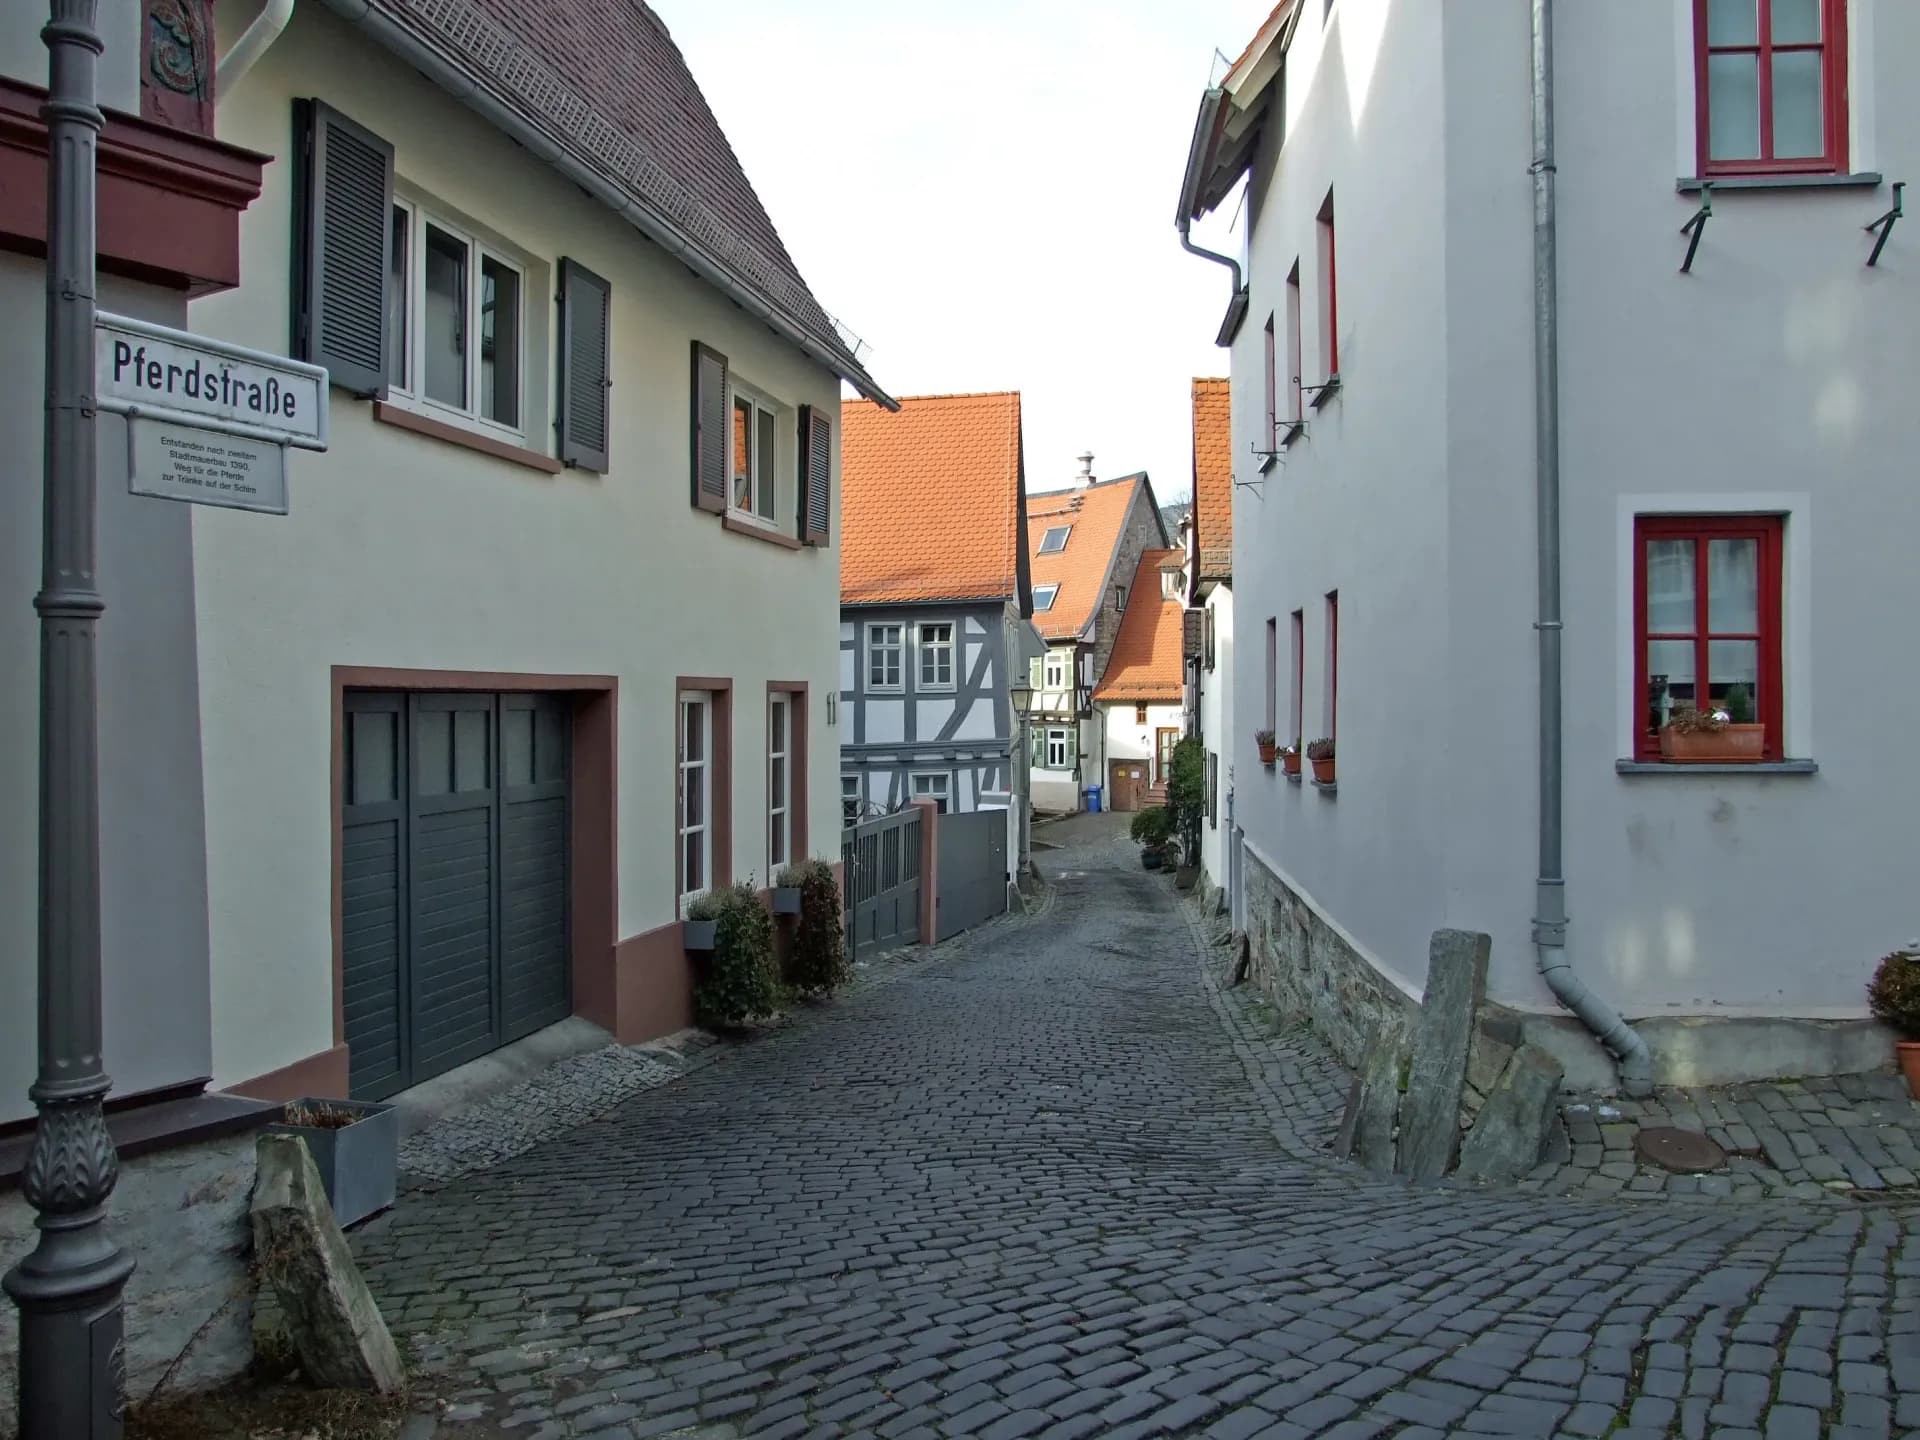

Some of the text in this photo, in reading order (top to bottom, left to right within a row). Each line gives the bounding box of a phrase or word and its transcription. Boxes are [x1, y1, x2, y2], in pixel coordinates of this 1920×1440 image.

[114, 341, 296, 418] Pferdstraße
[160, 436, 204, 451] Entstanden
[206, 446, 224, 455] nach
[169, 450, 227, 467] Stadtmauerbau
[174, 462, 244, 481] Weg für die Pferde
[206, 480, 217, 488] auf
